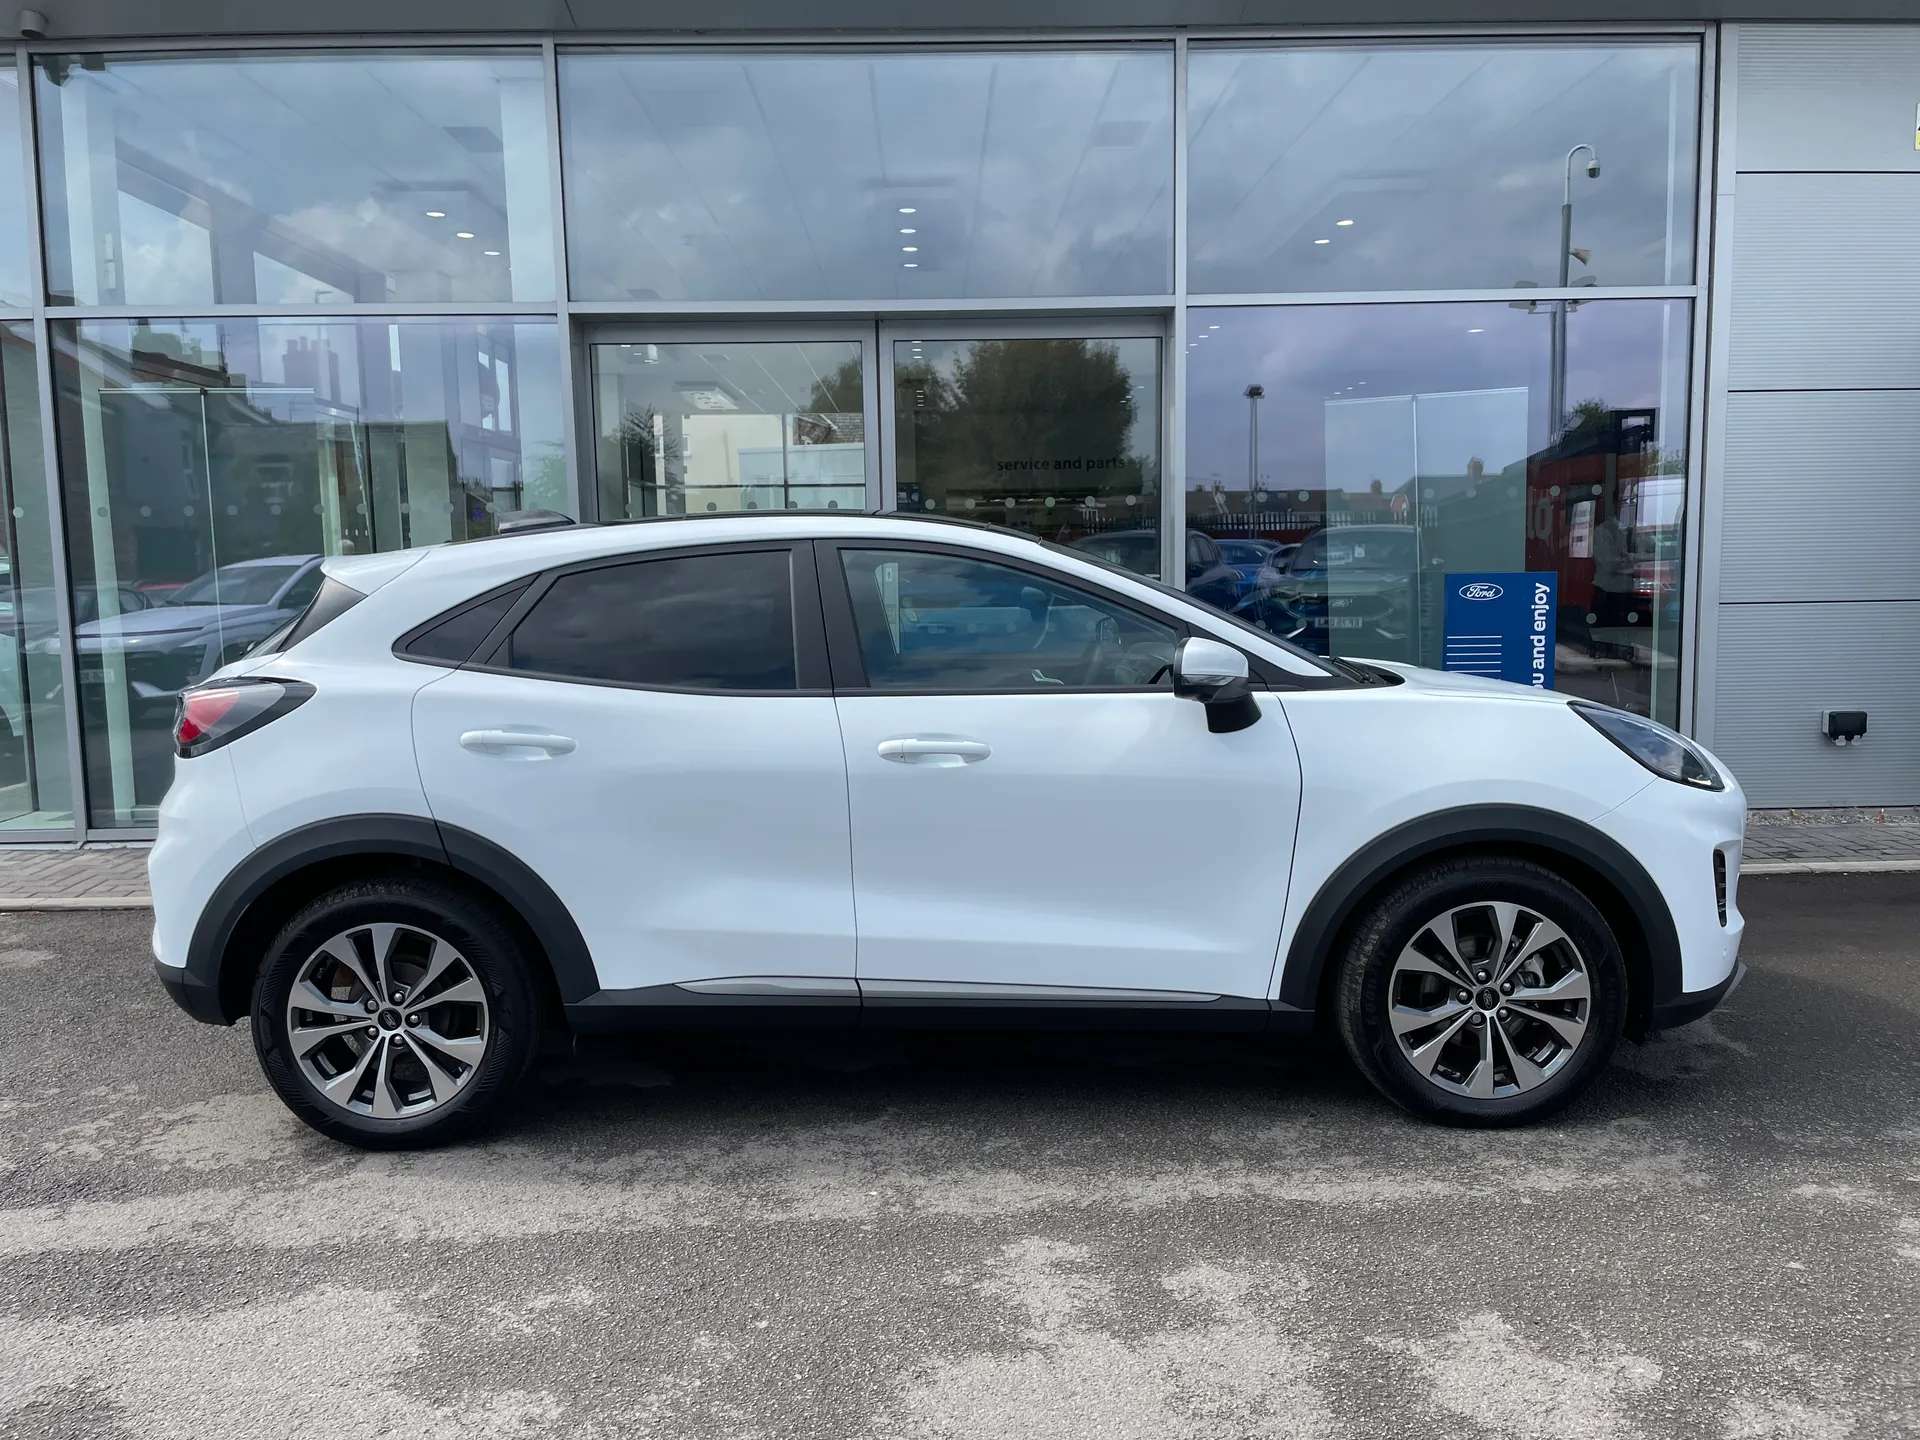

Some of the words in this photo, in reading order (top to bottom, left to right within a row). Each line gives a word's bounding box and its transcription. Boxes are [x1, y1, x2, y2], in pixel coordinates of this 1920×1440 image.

[996, 457, 1050, 471] service
[1054, 456, 1082, 470] and
[1086, 456, 1126, 472] parts
[1465, 584, 1497, 599] Ford
[1531, 582, 1551, 632] enjoy
[1530, 635, 1546, 670] and
